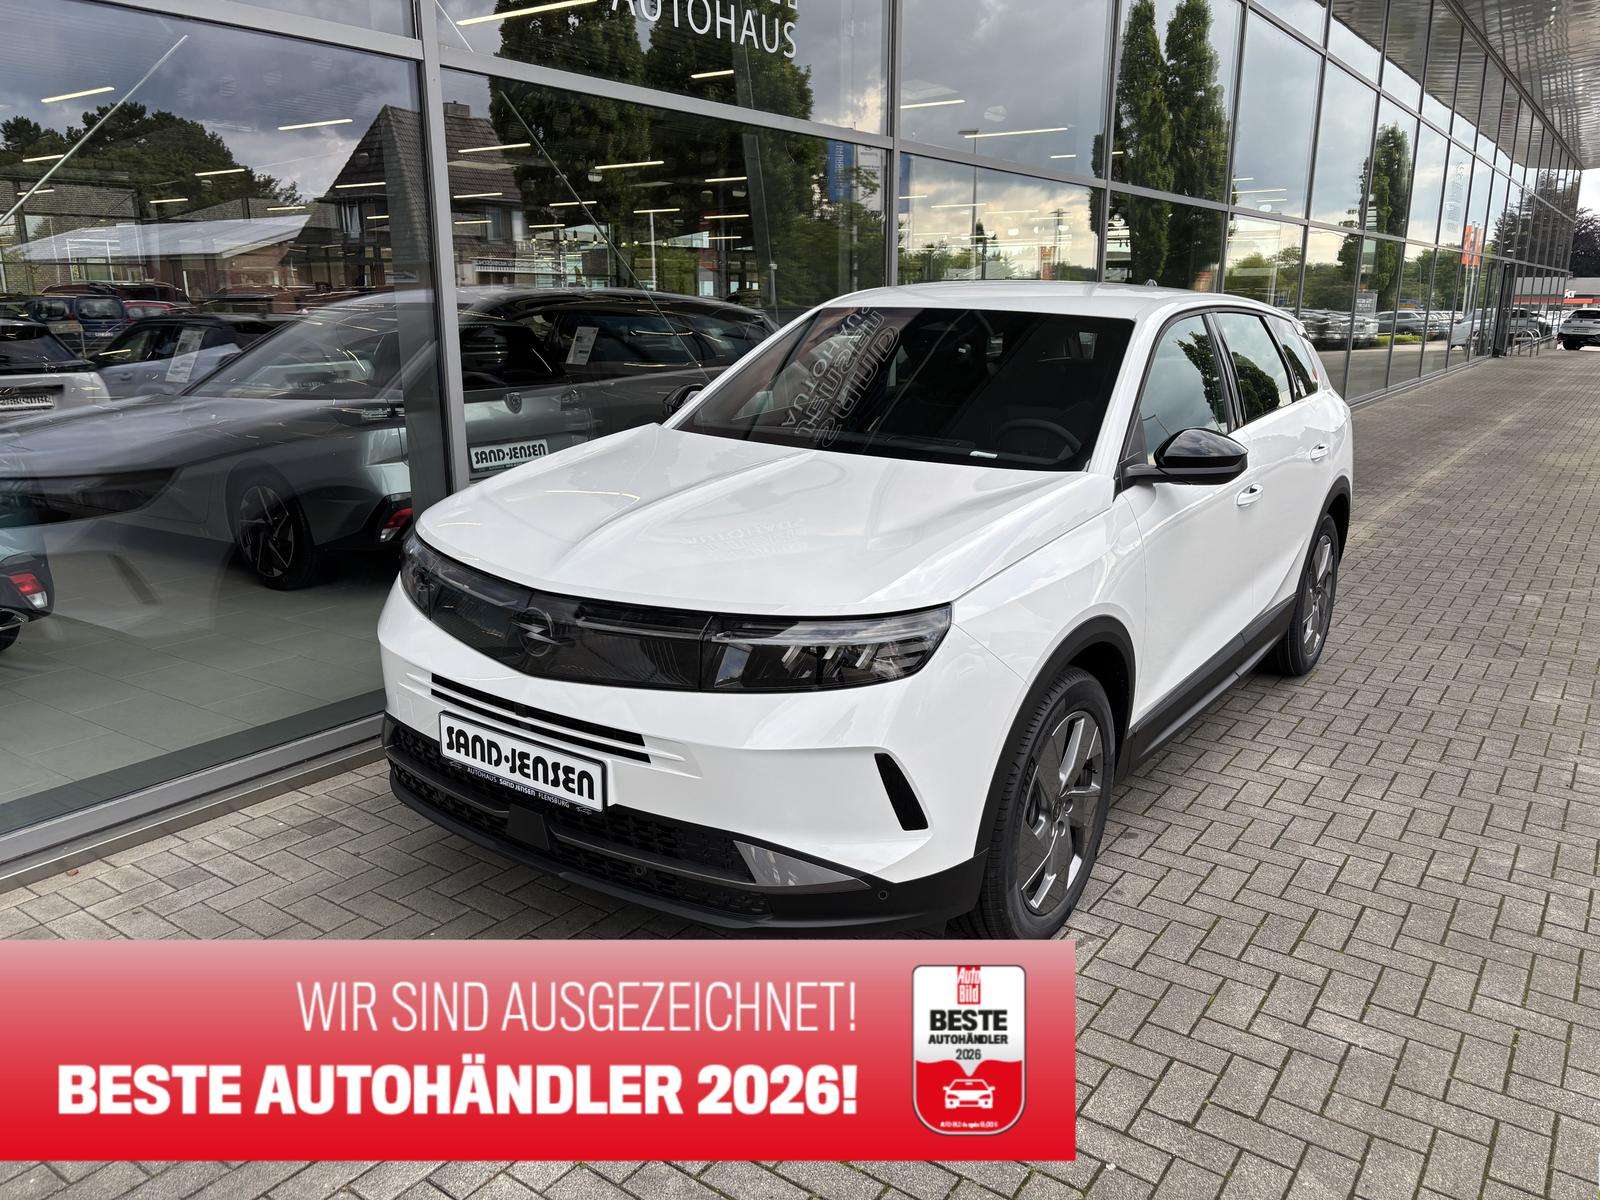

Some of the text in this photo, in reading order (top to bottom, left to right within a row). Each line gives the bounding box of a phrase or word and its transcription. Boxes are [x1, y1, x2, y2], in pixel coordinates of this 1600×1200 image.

[467, 767, 570, 809] AUTOHAUS SAND JENSEN FLENSBURG
